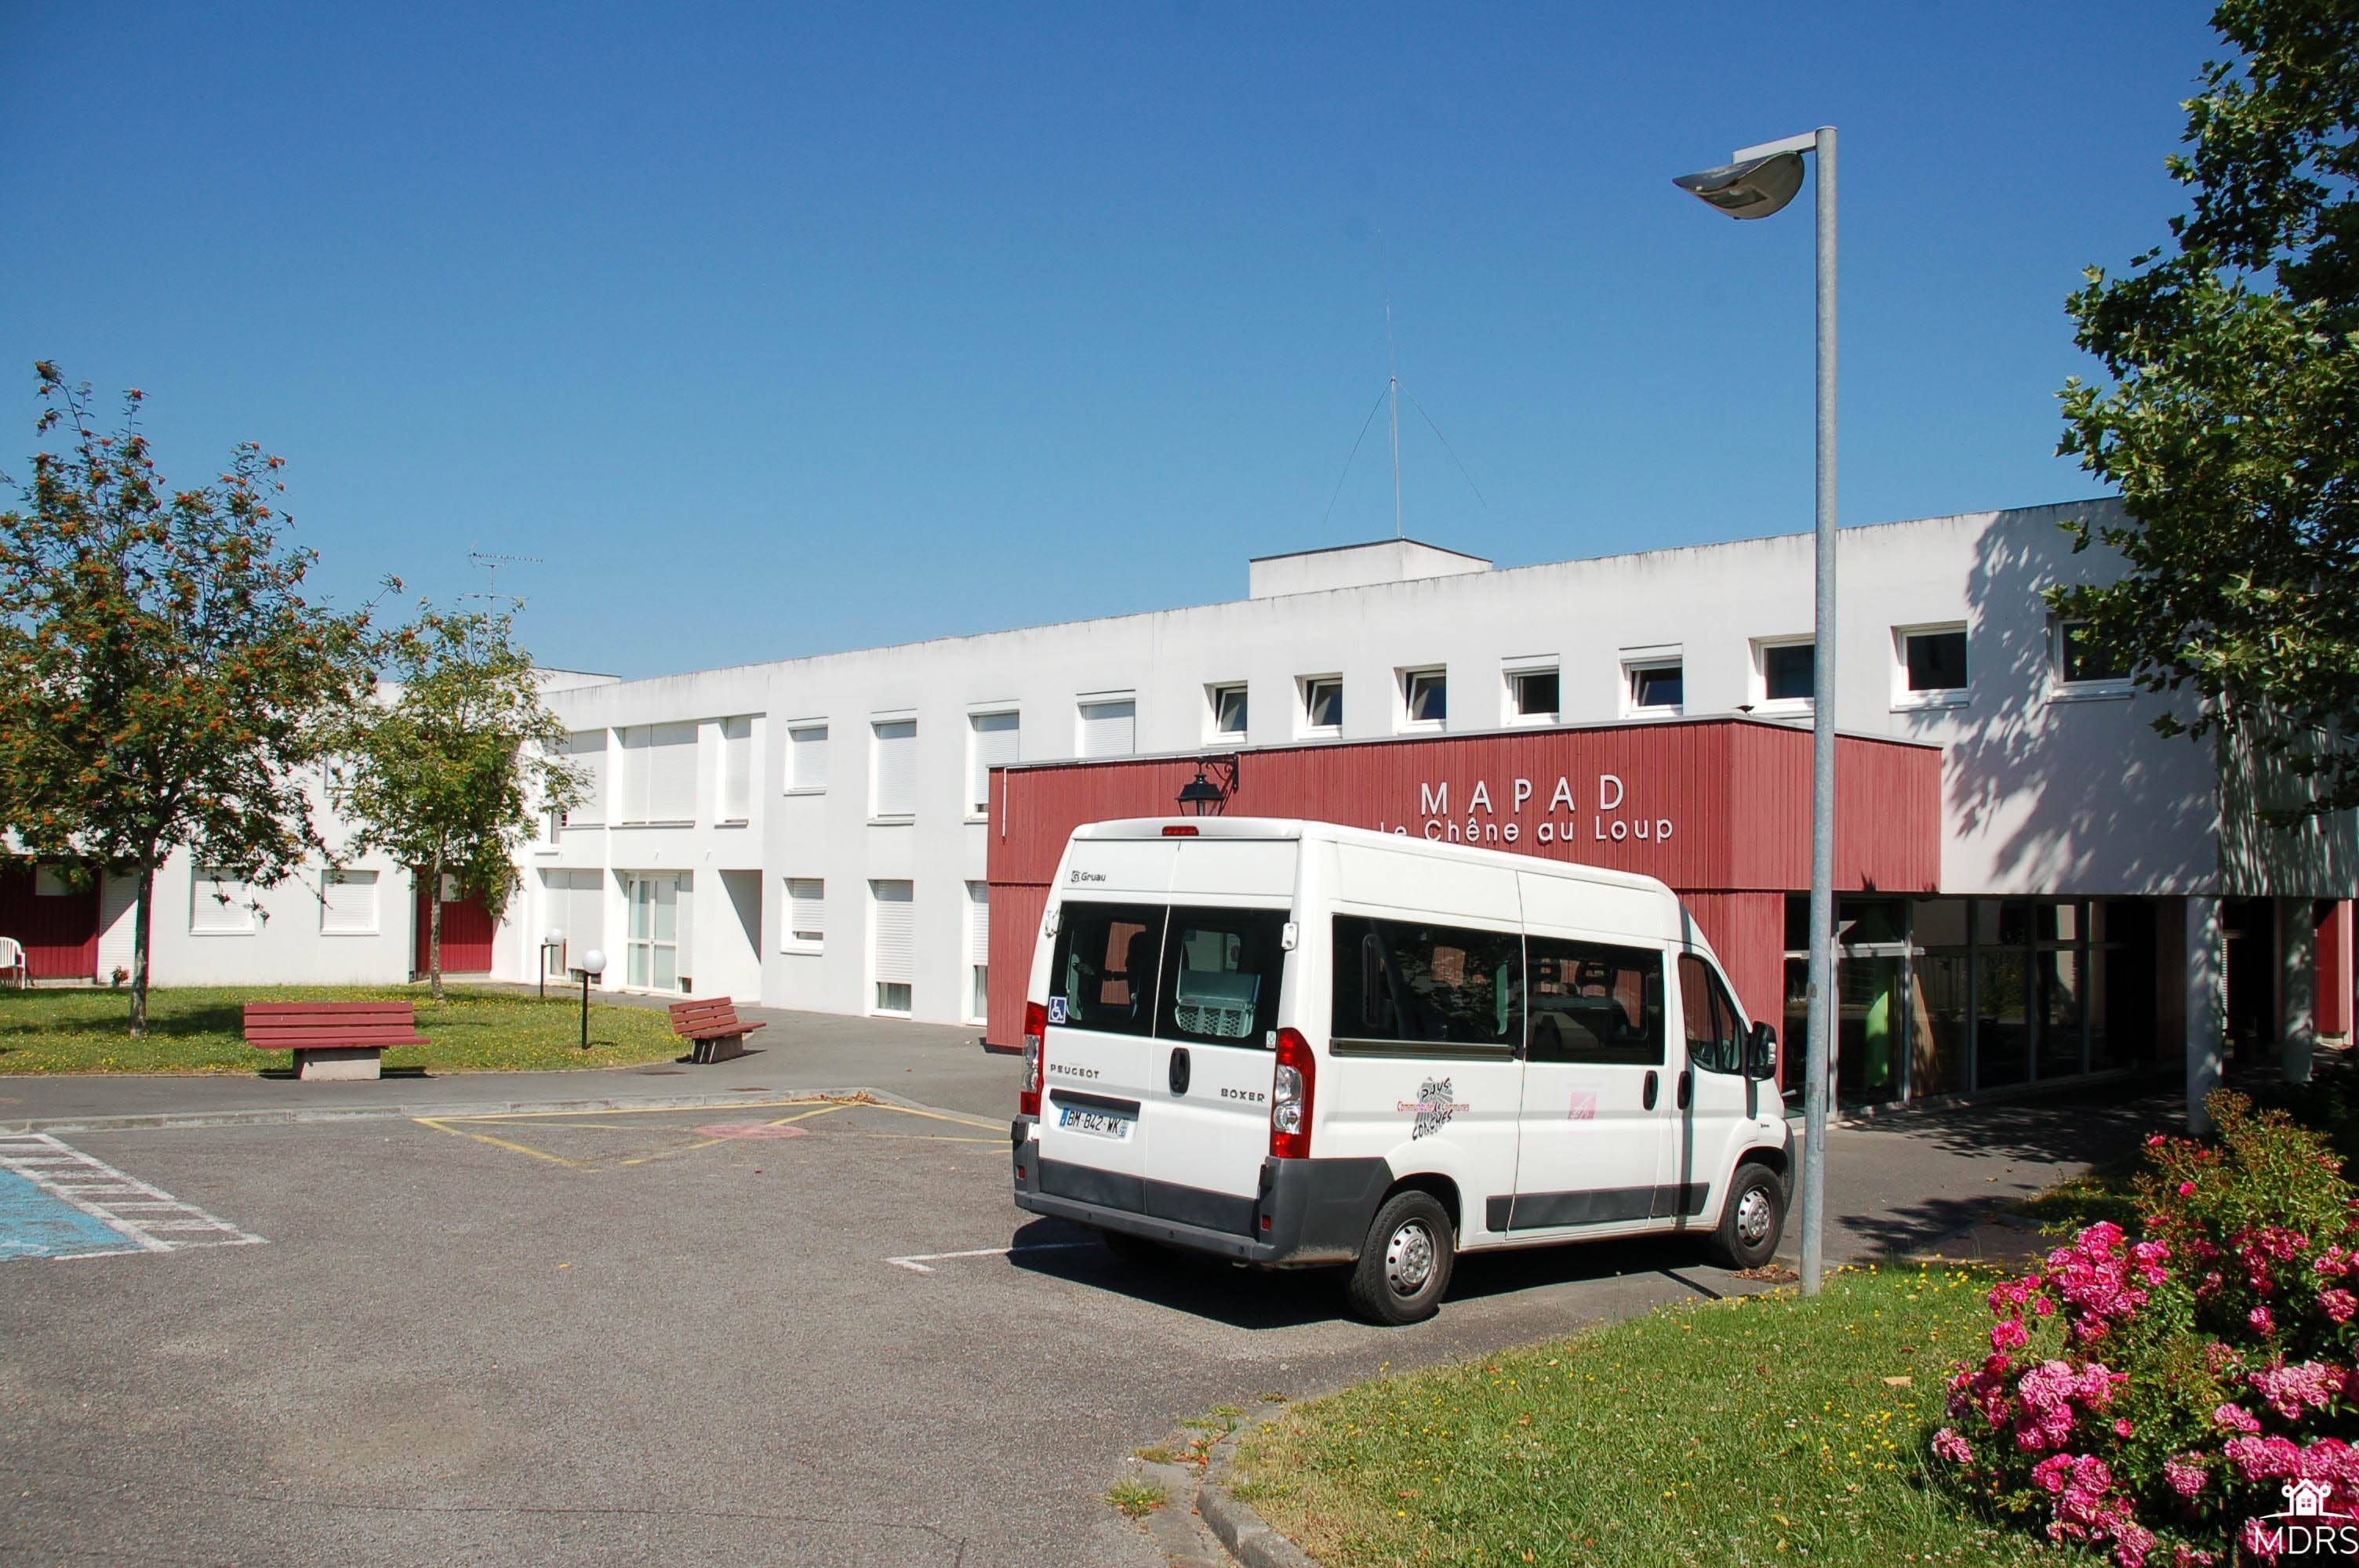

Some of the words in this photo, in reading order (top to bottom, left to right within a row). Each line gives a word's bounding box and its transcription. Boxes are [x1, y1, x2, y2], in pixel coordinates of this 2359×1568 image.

[1420, 775, 1623, 815] MAPAD
[1424, 817, 1519, 842] Chêne
[1537, 822, 1574, 841] au
[1595, 815, 1673, 844] Loup
[1081, 872, 1106, 881] Gruau
[1050, 1064, 1100, 1079] PEUGEOT
[1221, 1088, 1265, 1102] BOXER
[1421, 1077, 1449, 1100] PAYS
[1412, 1109, 1453, 1141] CONCHES
